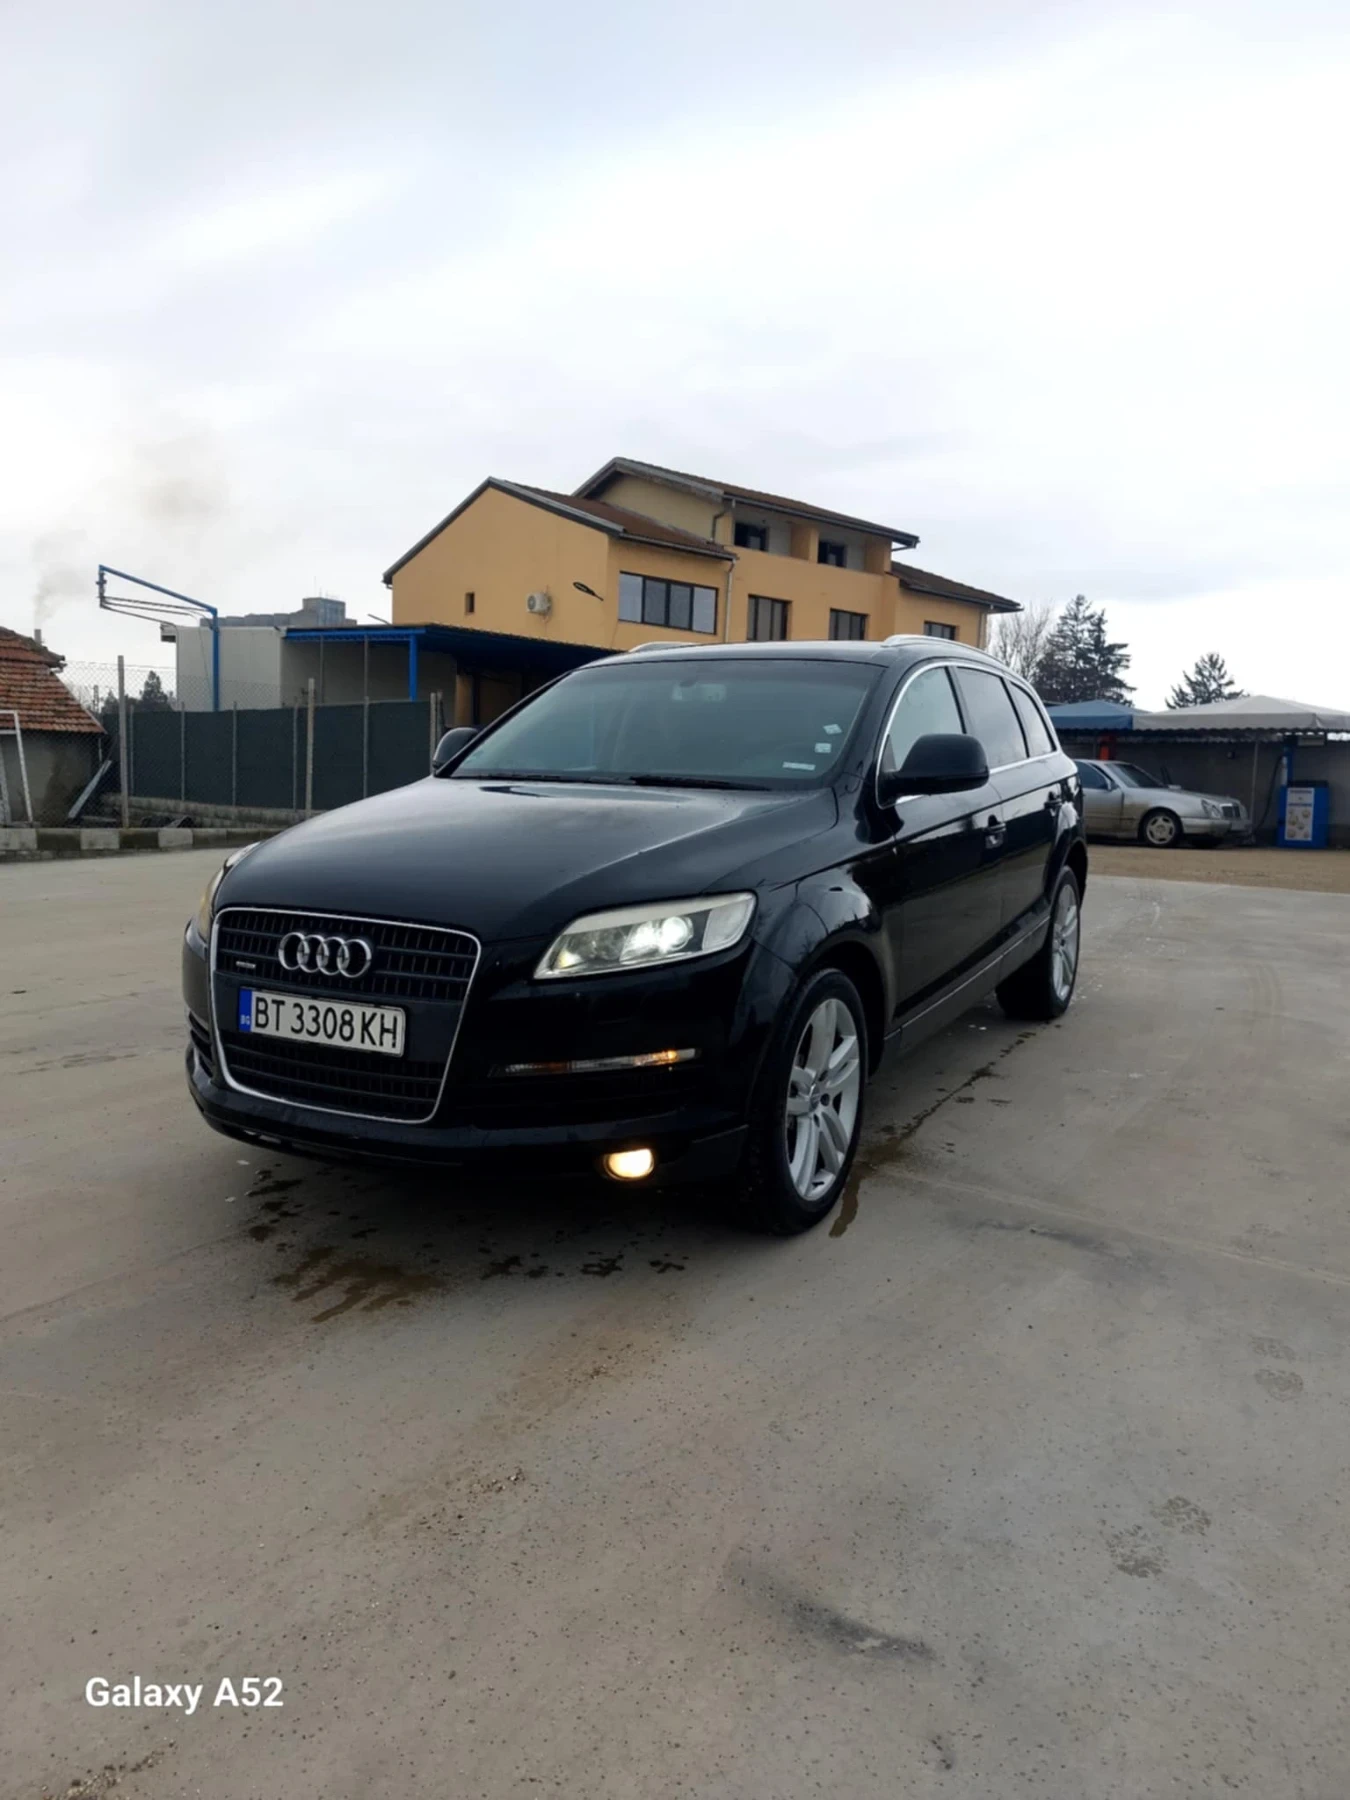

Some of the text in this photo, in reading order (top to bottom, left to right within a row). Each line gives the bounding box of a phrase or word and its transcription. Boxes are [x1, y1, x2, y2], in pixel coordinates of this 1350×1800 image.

[254, 996, 398, 1049] BT 3308 KH
